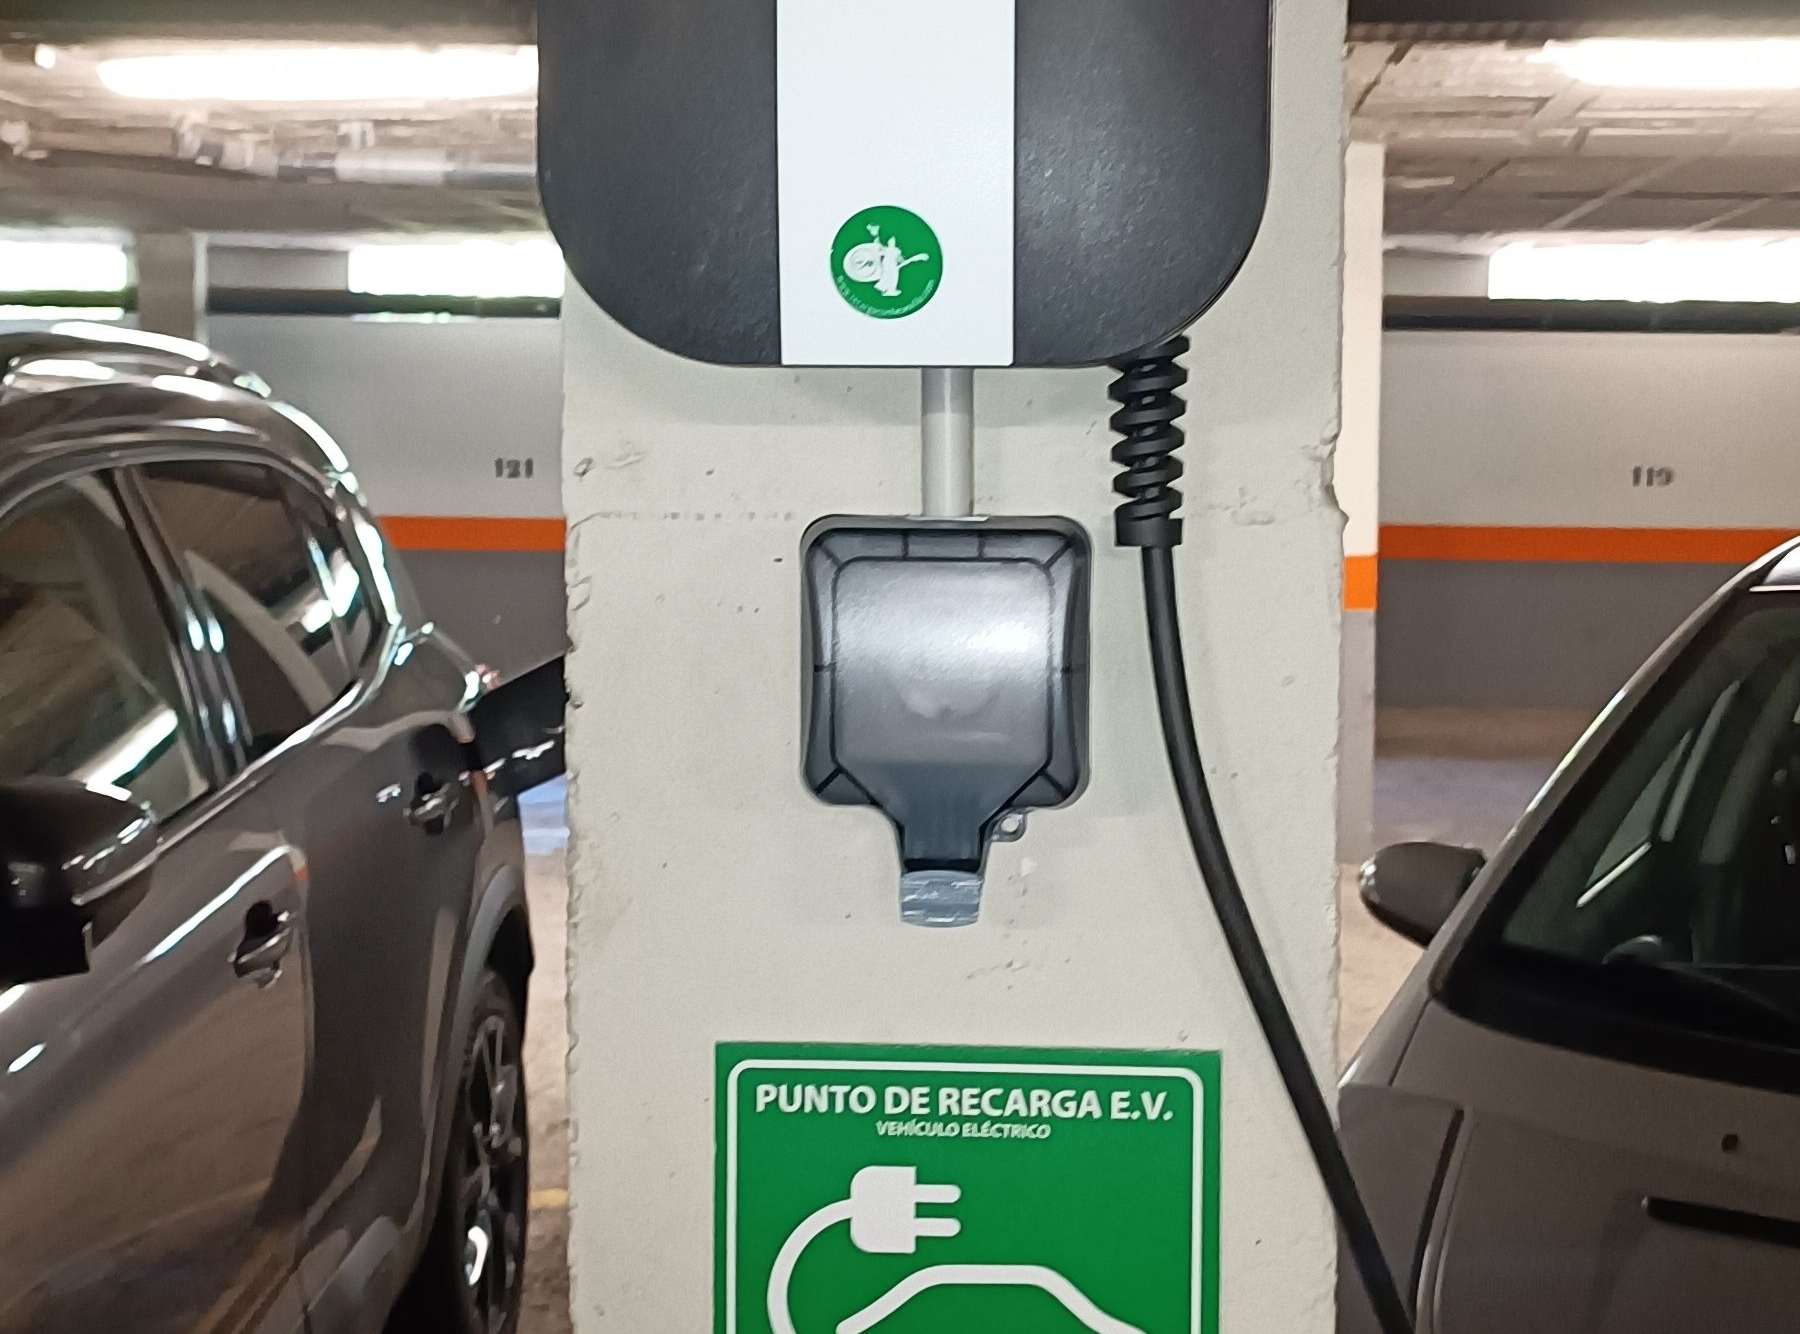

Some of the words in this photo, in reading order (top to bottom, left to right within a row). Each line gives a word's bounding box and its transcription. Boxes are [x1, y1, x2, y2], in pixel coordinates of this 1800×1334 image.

[495, 457, 534, 479] 121
[755, 1083, 877, 1114] PUNTO
[884, 1085, 931, 1115] DE
[938, 1086, 1103, 1119] RECARGA
[1110, 1090, 1174, 1121] E.V.
[875, 1118, 961, 1138] VEHÍCULO
[961, 1120, 1051, 1139] ELÉCTRICO
